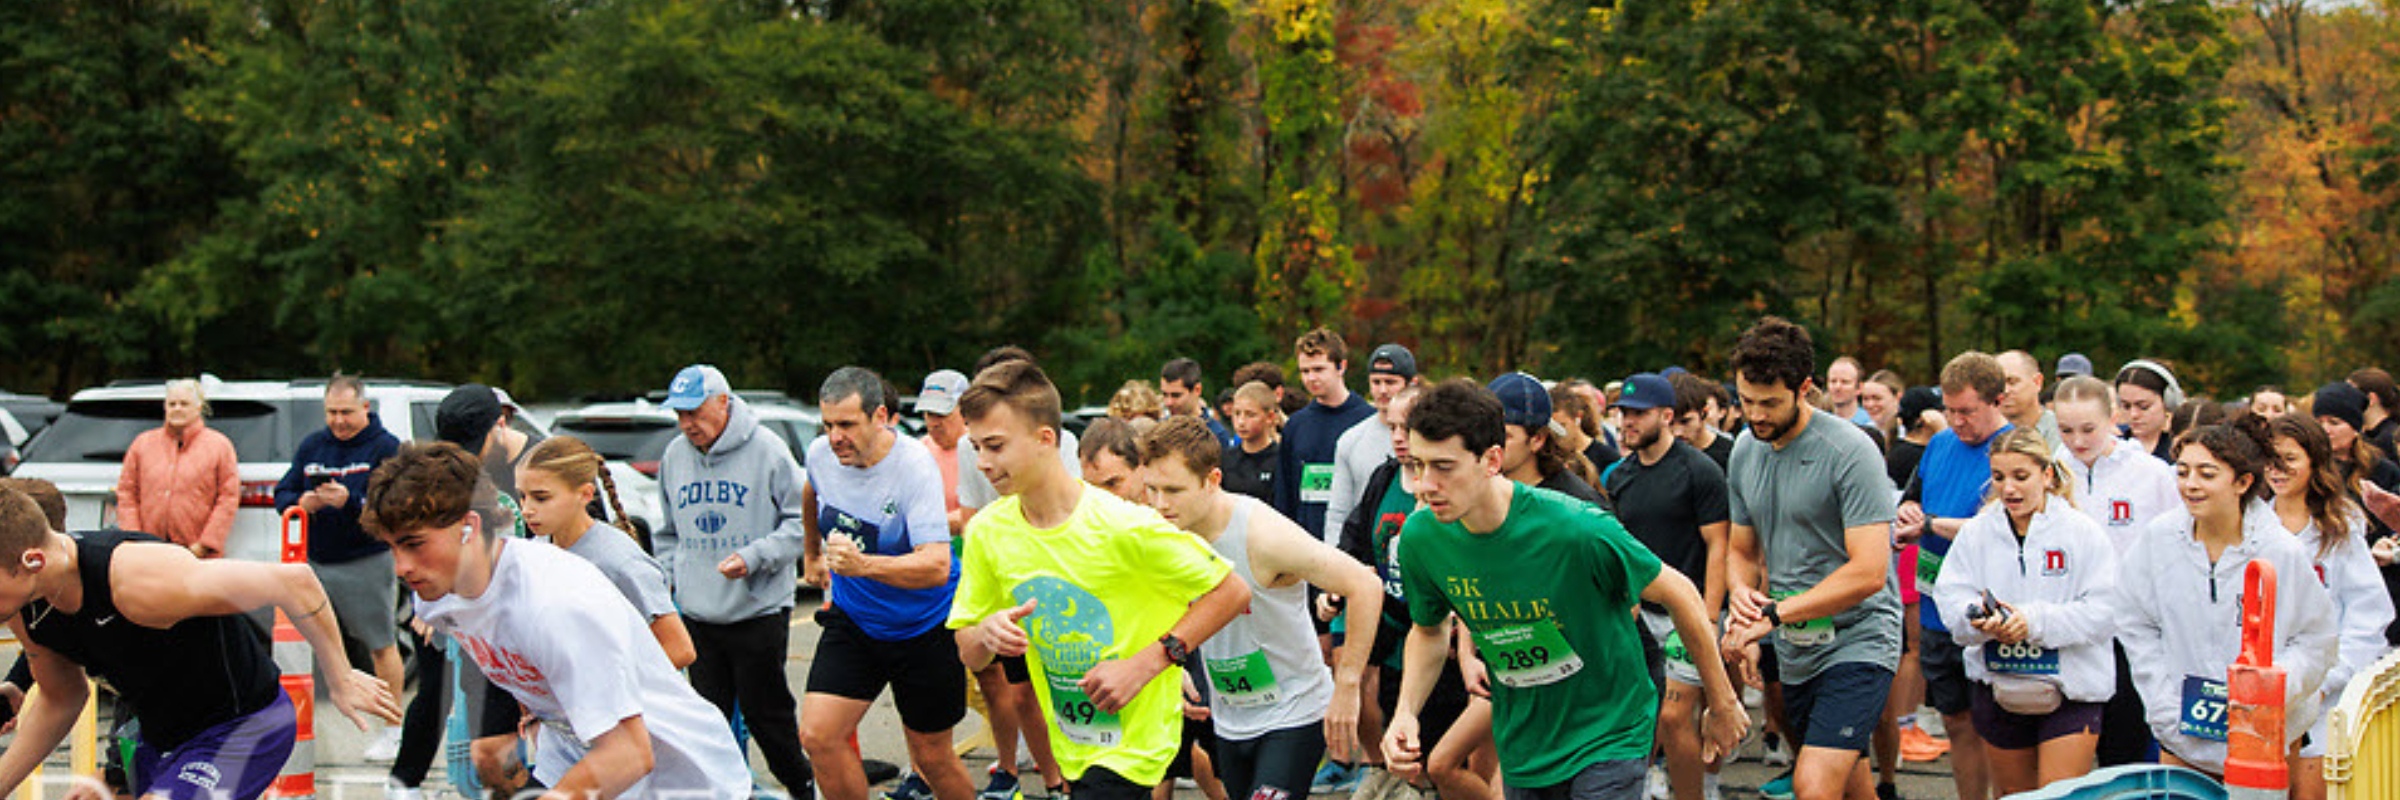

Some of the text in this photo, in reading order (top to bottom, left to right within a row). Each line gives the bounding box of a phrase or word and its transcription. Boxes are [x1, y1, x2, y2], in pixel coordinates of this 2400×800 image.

[678, 480, 749, 509] COLBY
[1447, 583, 1483, 597] 5K
[1499, 646, 1549, 671] 289
[1221, 676, 1252, 694] 34
[1062, 701, 1096, 725] 49
[2190, 699, 2228, 724] 67
